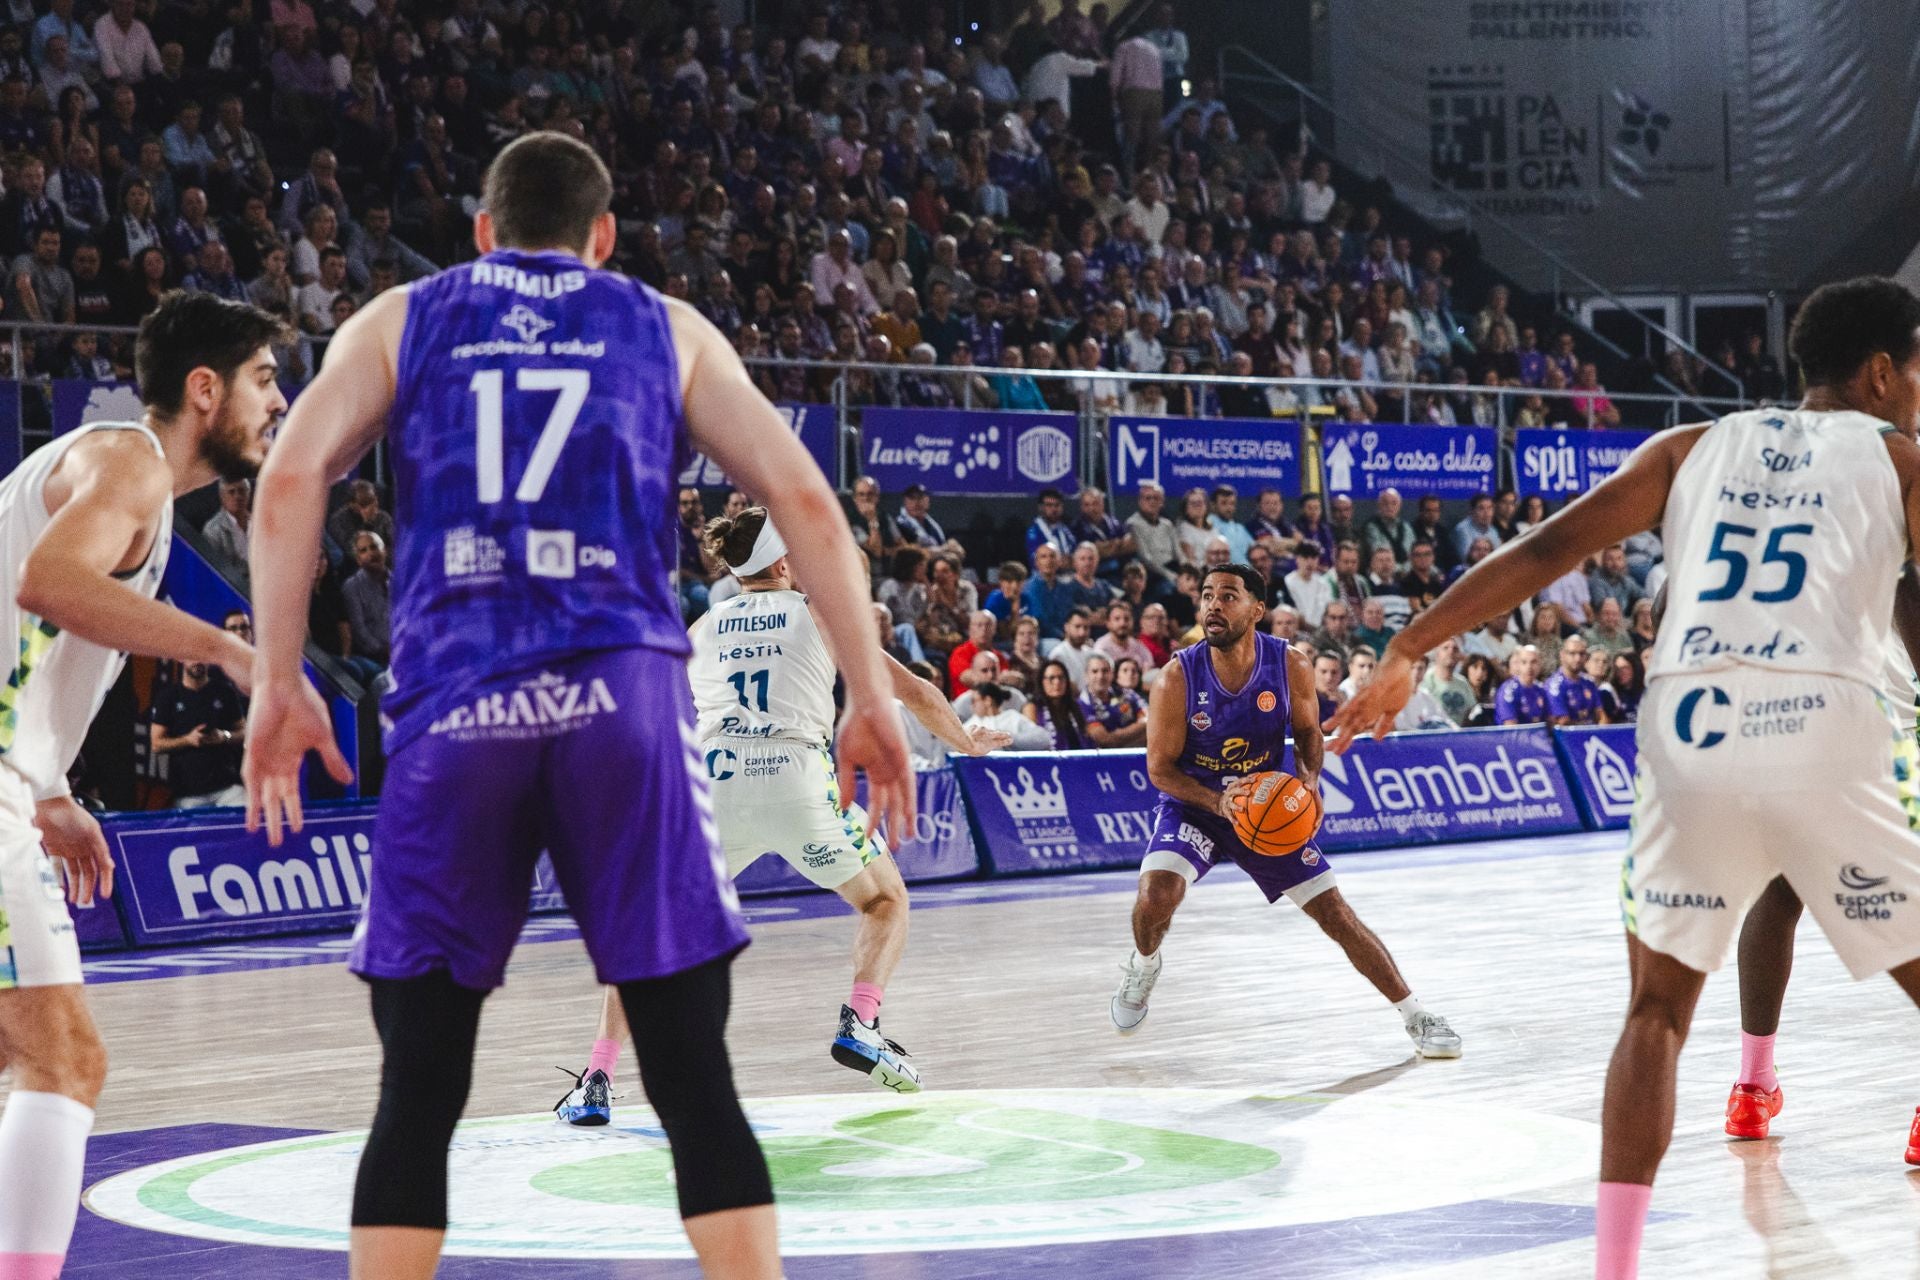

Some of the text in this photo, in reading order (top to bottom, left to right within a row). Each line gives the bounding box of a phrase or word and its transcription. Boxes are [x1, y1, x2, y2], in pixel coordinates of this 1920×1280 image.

[1516, 95, 1562, 124] PA
[1517, 127, 1588, 156] LEN
[1517, 160, 1581, 190] CIA
[471, 261, 587, 299] ARMUS
[468, 367, 592, 504] 17
[1394, 449, 1441, 472] casa
[1443, 433, 1494, 473] dulce
[1697, 520, 1815, 604] 55
[717, 612, 788, 635] LITTLESON
[726, 668, 770, 714] 11
[1743, 692, 1827, 717] carreras
[428, 677, 619, 735] EBANZA
[1740, 714, 1808, 738] center
[744, 755, 791, 767] carreras
[744, 765, 781, 778] center
[1352, 744, 1556, 811] lambda
[1835, 889, 1907, 908] Esports
